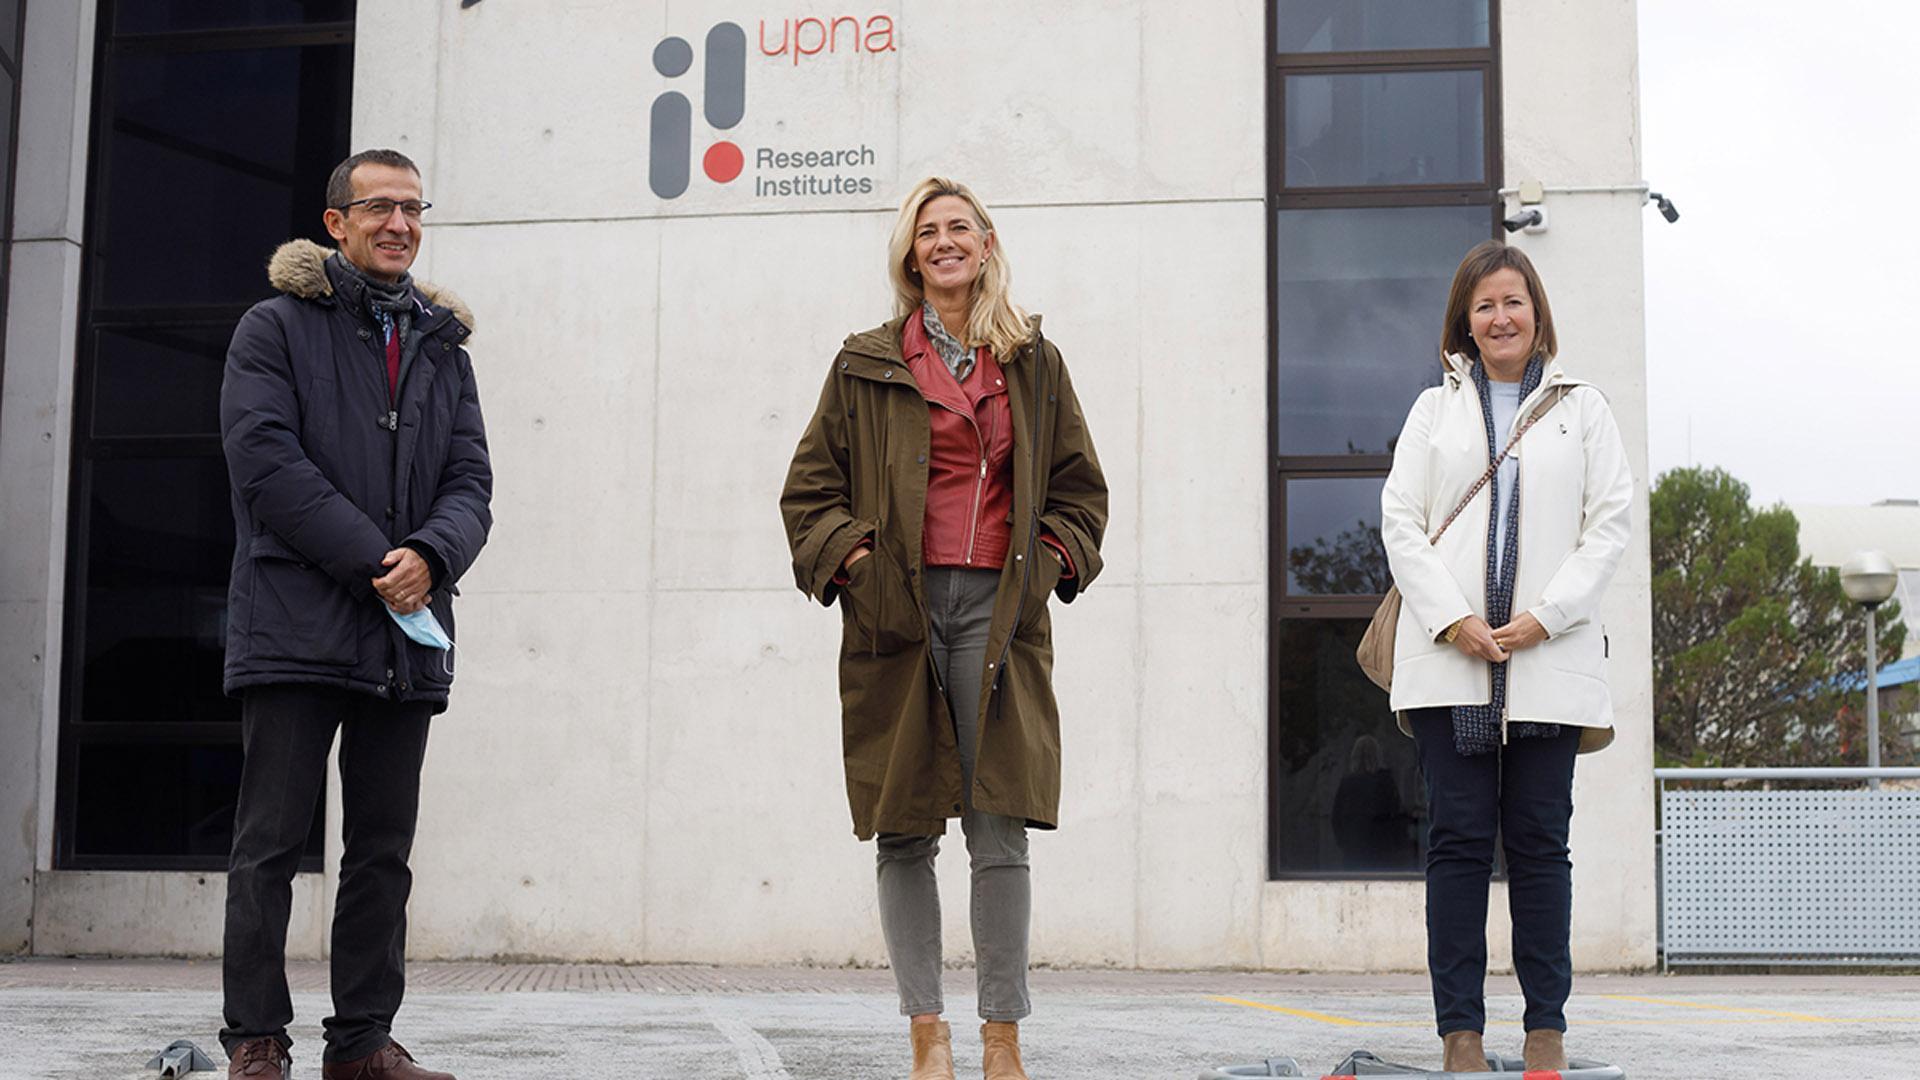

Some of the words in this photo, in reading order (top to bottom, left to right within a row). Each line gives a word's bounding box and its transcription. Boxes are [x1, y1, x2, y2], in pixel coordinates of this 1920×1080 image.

[759, 15, 897, 66] upna
[756, 144, 875, 169] Research
[755, 174, 873, 197] Institutes
